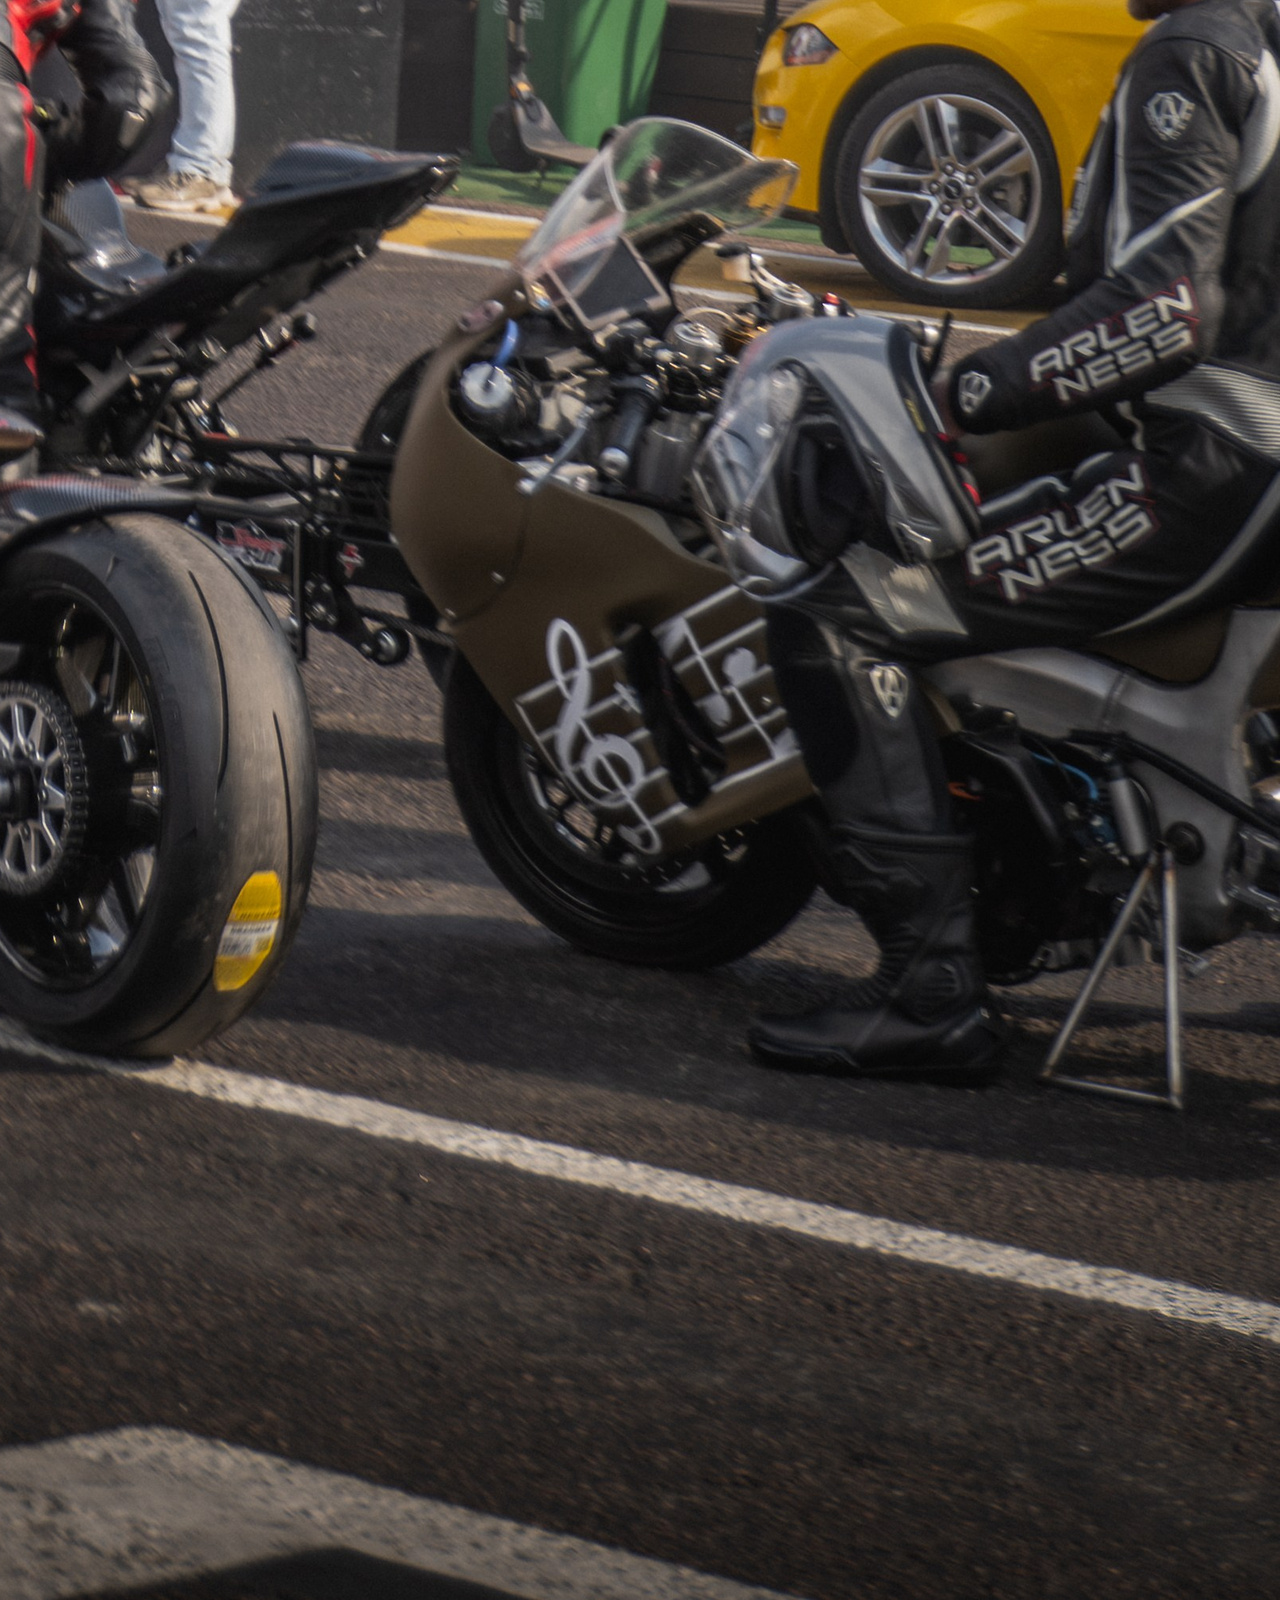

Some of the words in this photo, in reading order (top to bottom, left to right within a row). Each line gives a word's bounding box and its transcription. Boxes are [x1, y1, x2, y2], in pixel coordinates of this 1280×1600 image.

[1029, 284, 1195, 382] ARLEN
[1053, 320, 1194, 401] NESS
[966, 462, 1144, 576] ARLEN
[998, 502, 1154, 600] NESS
